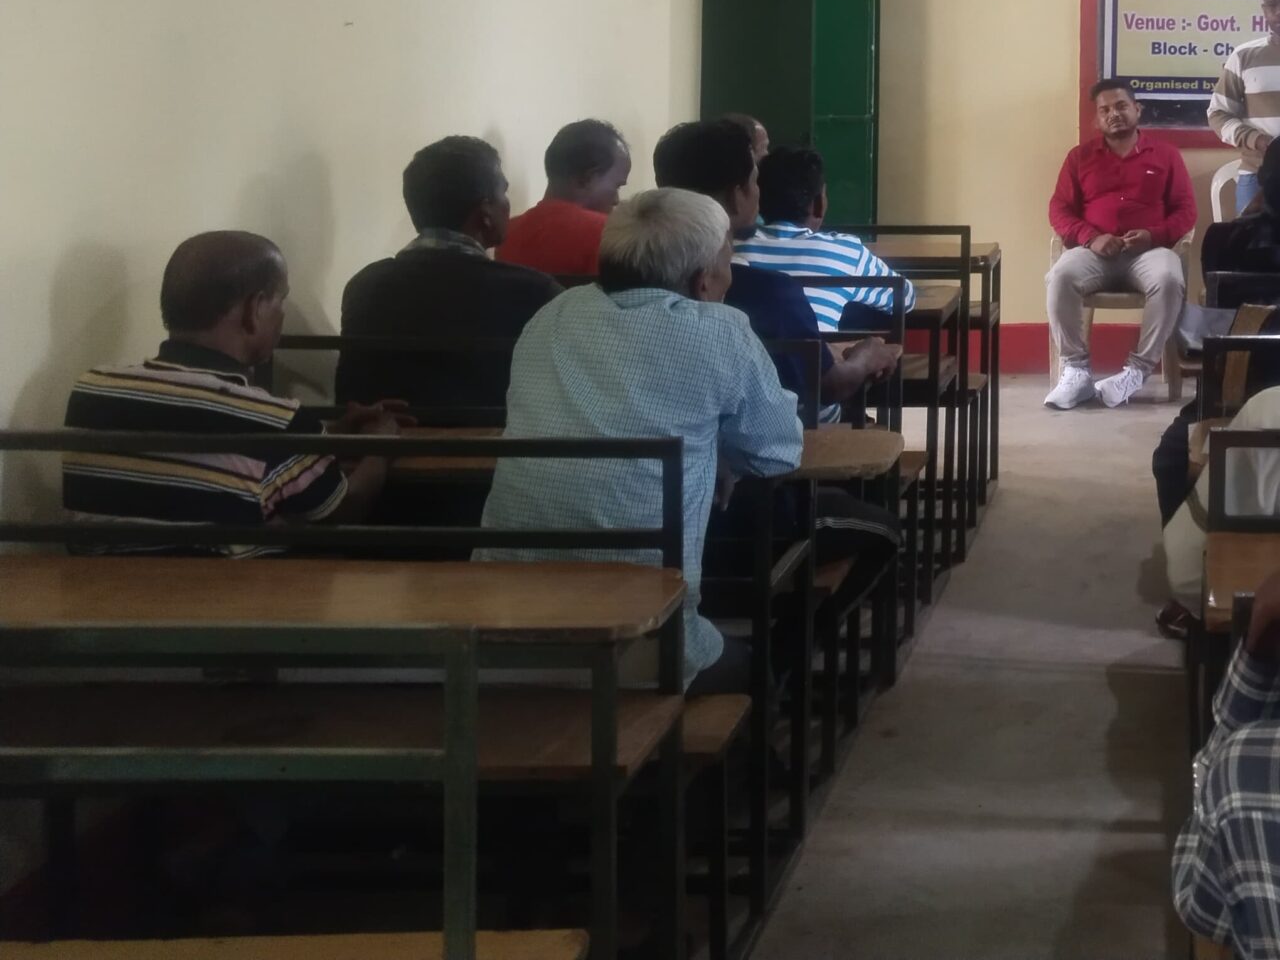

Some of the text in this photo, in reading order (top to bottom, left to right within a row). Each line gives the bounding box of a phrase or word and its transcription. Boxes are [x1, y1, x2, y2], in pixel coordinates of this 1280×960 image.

[1124, 13, 1176, 30] Venue
[1197, 14, 1241, 32] Govt.
[1151, 42, 1197, 56] Block
[1130, 78, 1198, 91] Organised
